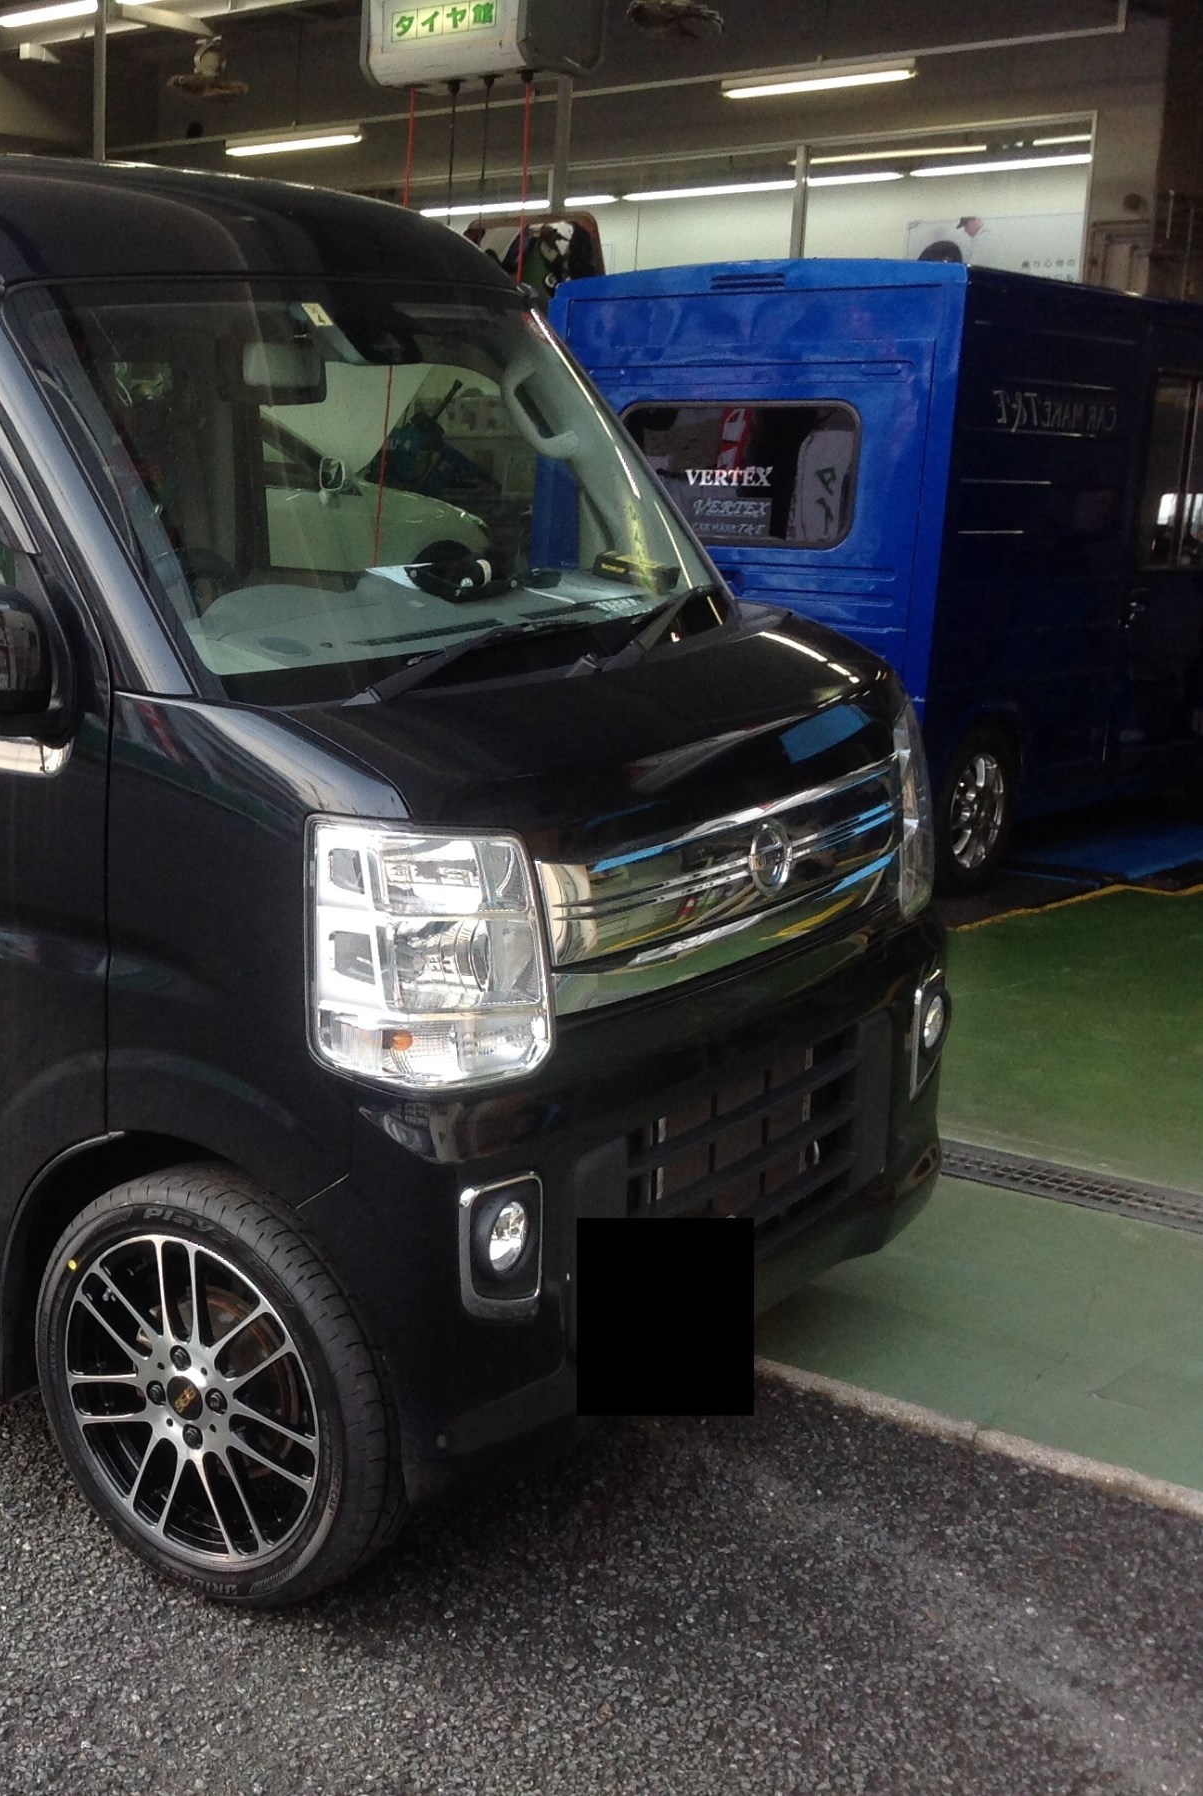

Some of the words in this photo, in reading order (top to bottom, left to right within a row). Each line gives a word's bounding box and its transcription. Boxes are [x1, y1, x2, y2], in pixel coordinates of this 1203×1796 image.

[395, 2, 494, 37] タイヤ館
[685, 466, 773, 487] VERTEX
[693, 498, 771, 518] VERTEX
